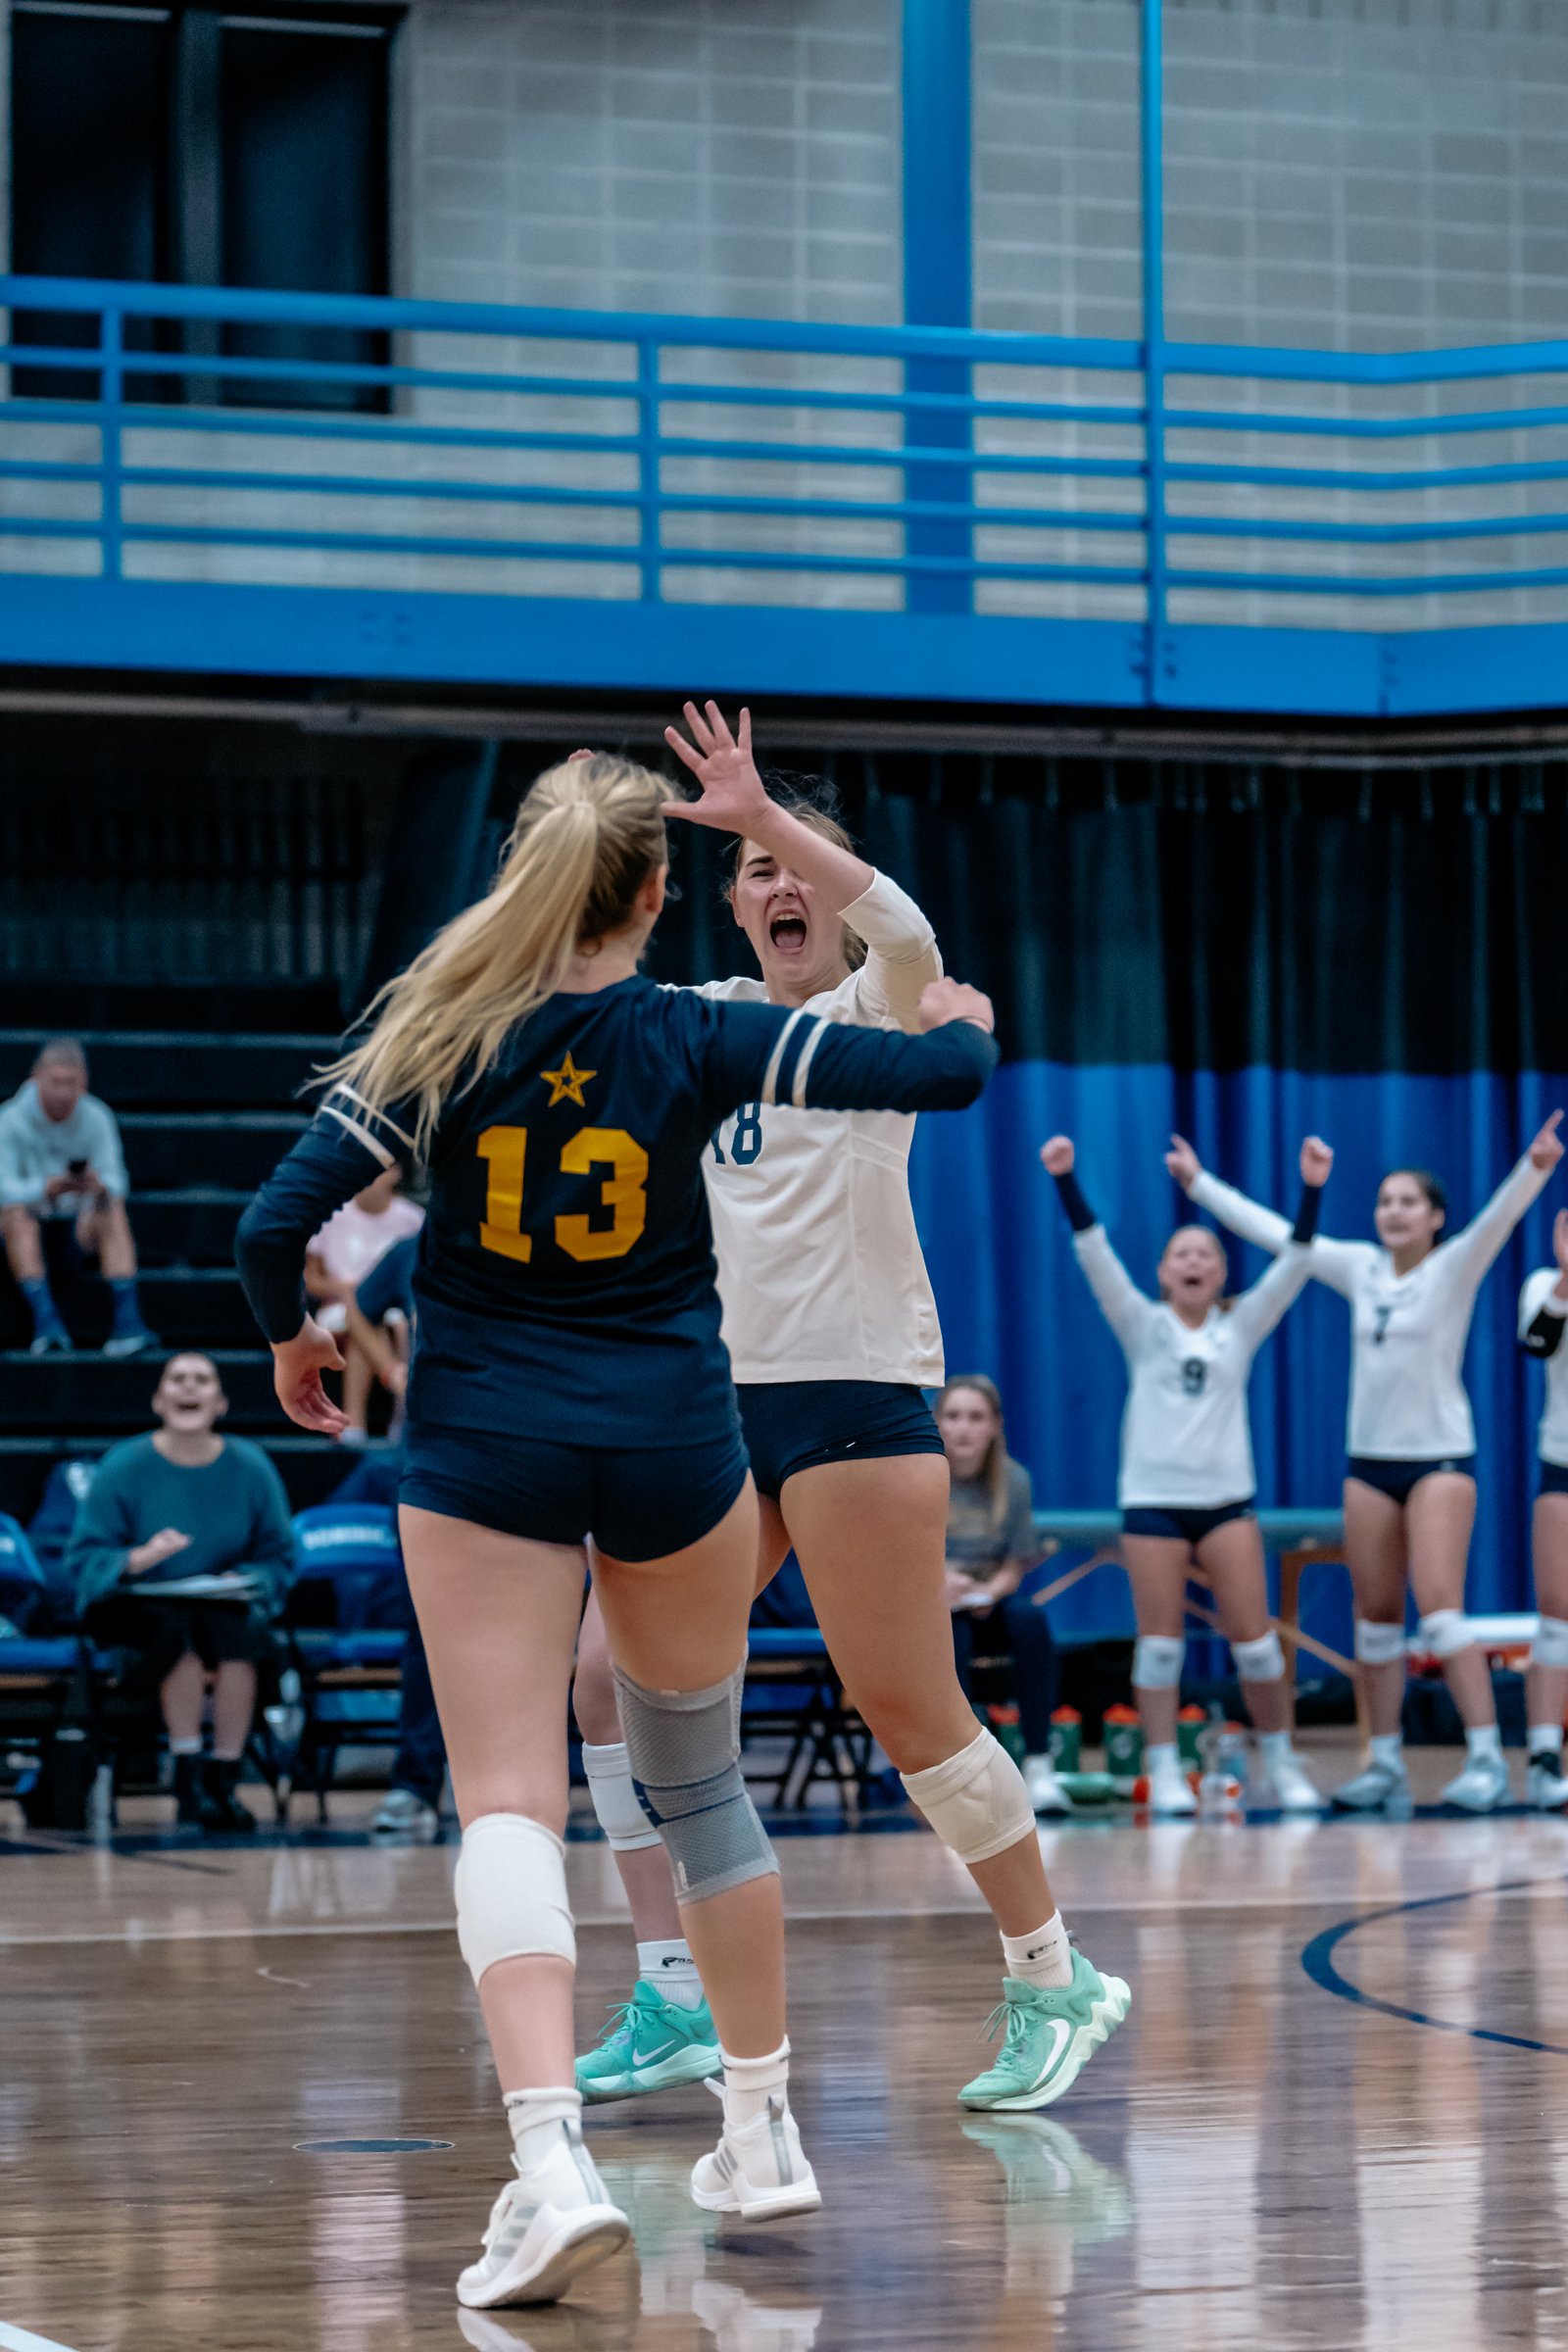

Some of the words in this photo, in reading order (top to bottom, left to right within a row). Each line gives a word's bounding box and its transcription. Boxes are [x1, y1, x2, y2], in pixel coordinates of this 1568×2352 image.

[476, 1125, 649, 1263] 13
[1373, 1304, 1393, 1347] 7
[1182, 1357, 1206, 1395] 9
